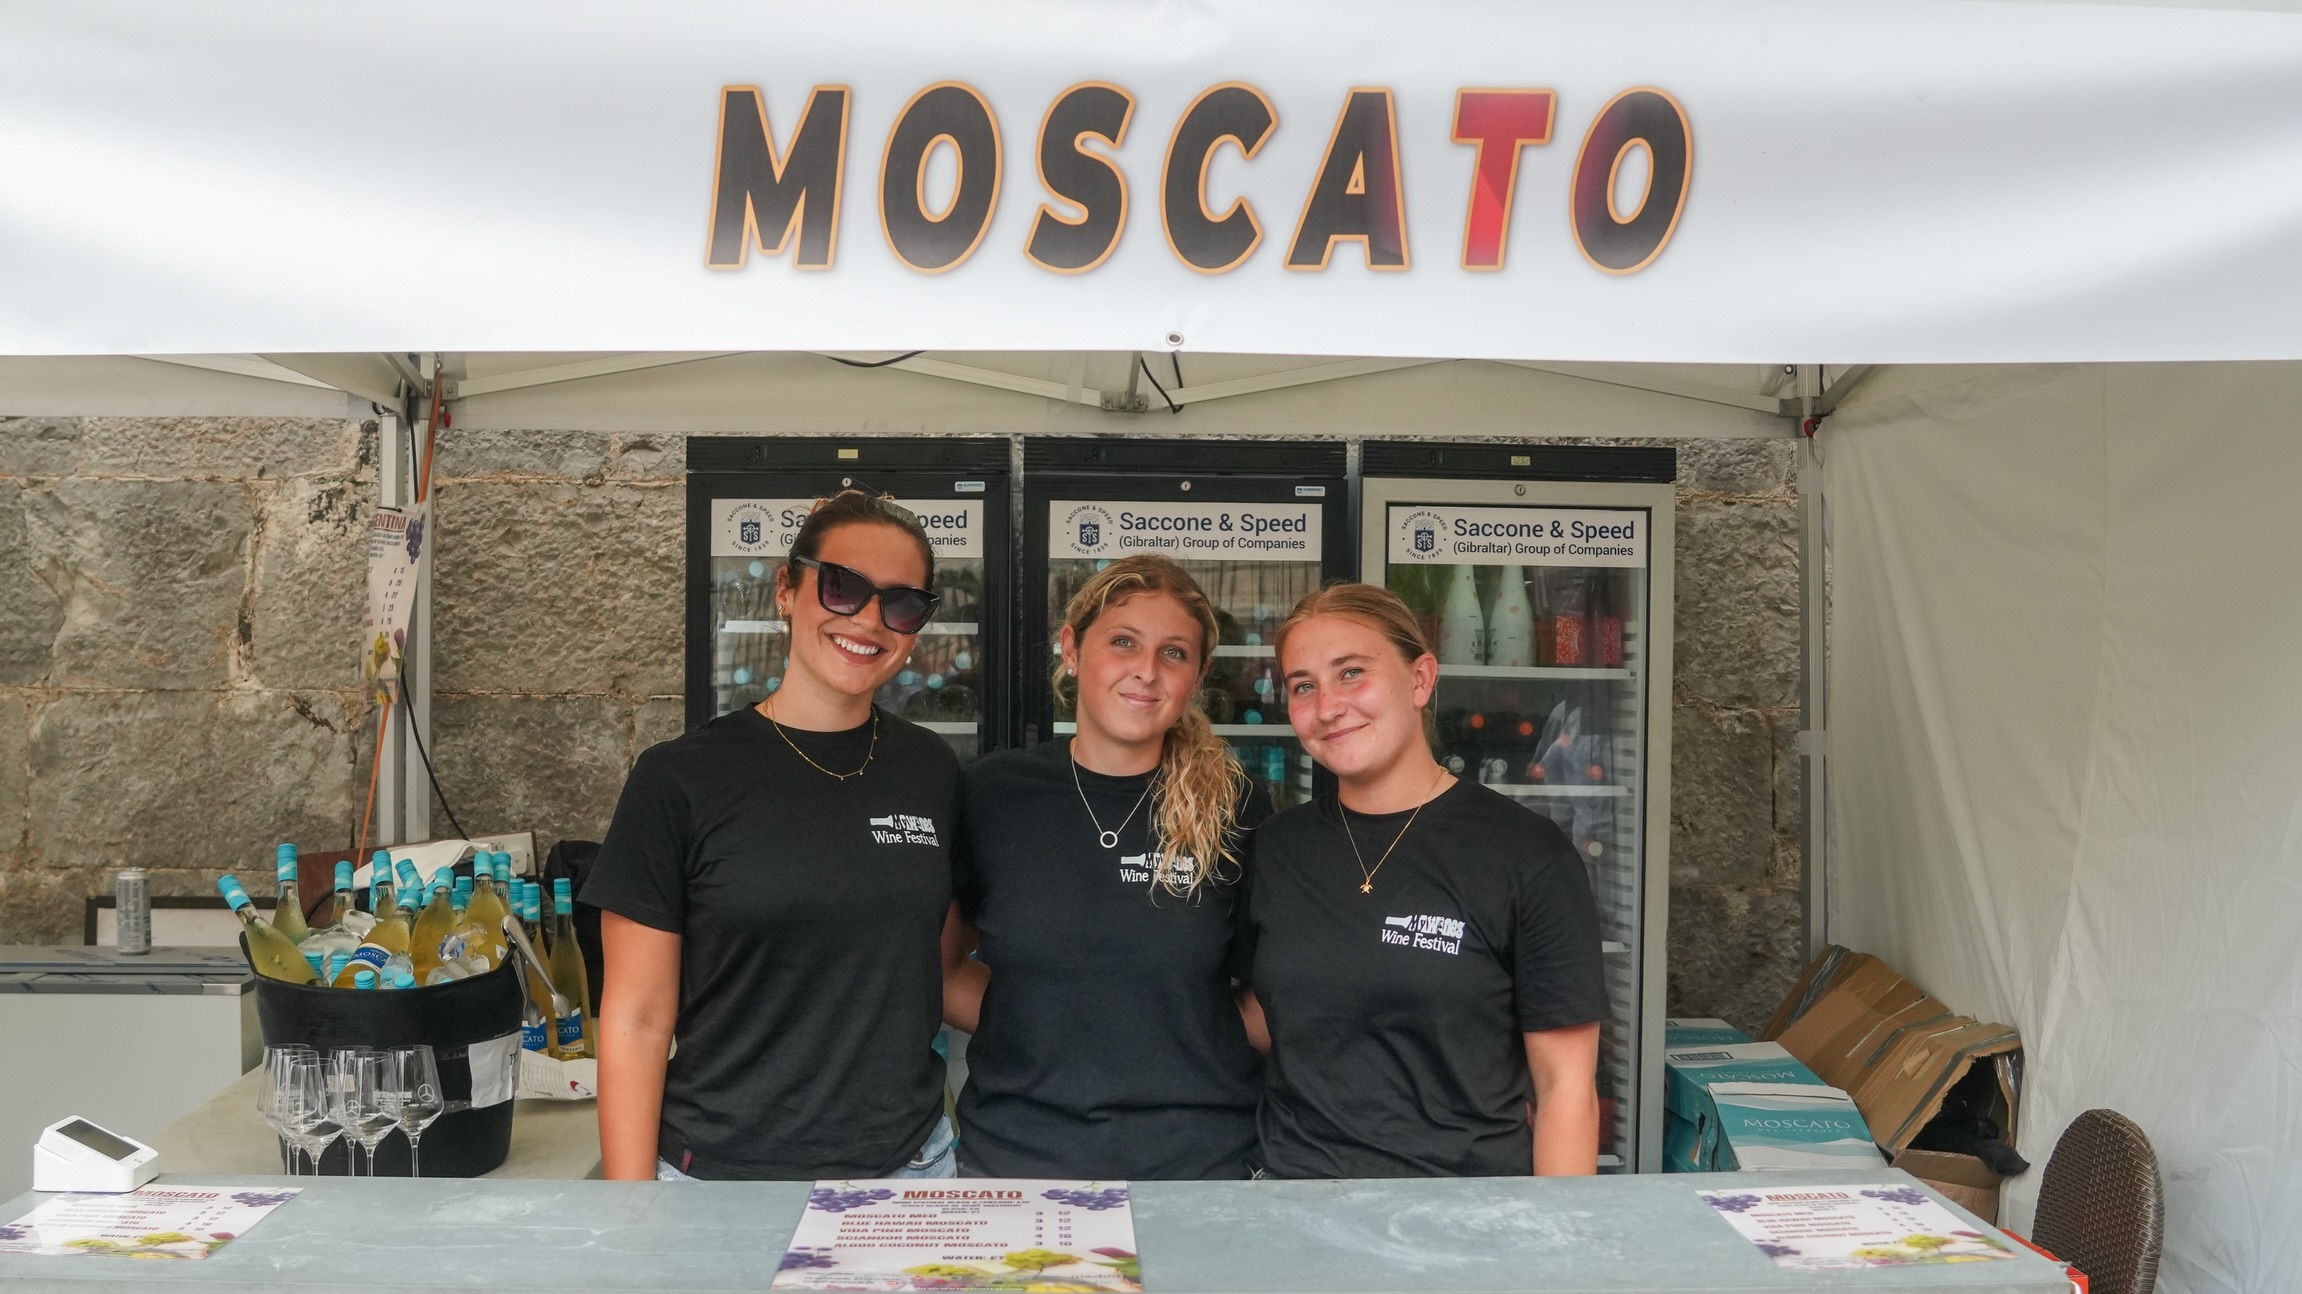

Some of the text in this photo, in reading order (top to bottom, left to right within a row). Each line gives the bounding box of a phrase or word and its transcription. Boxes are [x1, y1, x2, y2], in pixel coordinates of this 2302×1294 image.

[704, 82, 1695, 275] MOSCATO
[727, 503, 751, 522] SACCONE
[759, 505, 774, 522] SPEED
[1066, 505, 1090, 524] SACCONE
[1098, 508, 1113, 525] SPEED
[373, 513, 407, 530] ENTINA
[917, 510, 967, 530] peed
[1120, 512, 1307, 536] Saccone & Speed
[1401, 511, 1425, 530] SACCONE
[1433, 514, 1448, 531] SPEED
[1454, 518, 1635, 543] Saccone & Speed
[732, 540, 751, 552] SINCE
[927, 534, 967, 546] panies
[1119, 535, 1306, 552] (Gibraltar) Group of Companies
[1071, 543, 1089, 554] SINCE
[1406, 548, 1424, 560] SINCE
[1453, 541, 1634, 558] (Gibraltar) Group of Companies
[872, 831, 940, 847] Wine Festival
[1120, 869, 1149, 882] Wine
[1381, 929, 1461, 955] Wine Festival
[354, 951, 386, 962] MOSC
[558, 1026, 579, 1034] CATO
[523, 1035, 545, 1043] CATO
[1700, 1070, 1795, 1080] MOSCATO
[1744, 1119, 1850, 1129] MOSCATO
[132, 1190, 220, 1199] MOSCATO
[904, 1190, 1023, 1199] MOSCATO
[1765, 1192, 1850, 1201] MOSCATO
